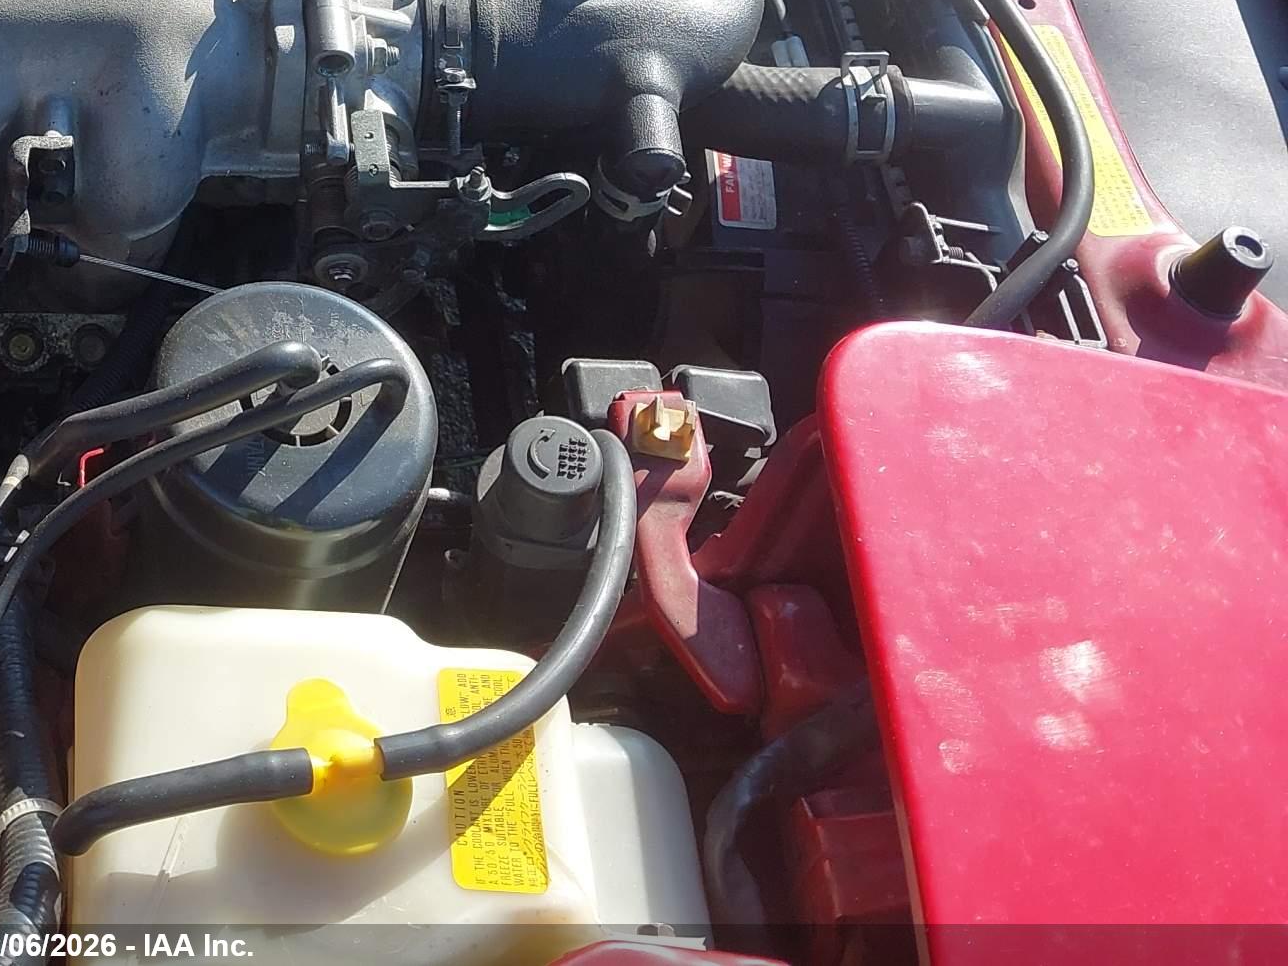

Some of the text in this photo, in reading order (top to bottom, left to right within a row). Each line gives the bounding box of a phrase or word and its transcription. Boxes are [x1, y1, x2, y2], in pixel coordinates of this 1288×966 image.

[457, 673, 466, 687] ADD
[480, 674, 491, 689] AND
[503, 758, 512, 783] WHEN
[480, 781, 490, 790] OF
[454, 789, 468, 846] CAUTION
[482, 798, 493, 833] MIXTURE
[493, 806, 507, 846] SUITABLE
[469, 811, 483, 849] COOLANT
[507, 822, 518, 836] THE
[510, 842, 520, 851] TO
[473, 856, 484, 870] THE
[499, 854, 512, 886] FREEZE
[511, 858, 525, 886] WATER
